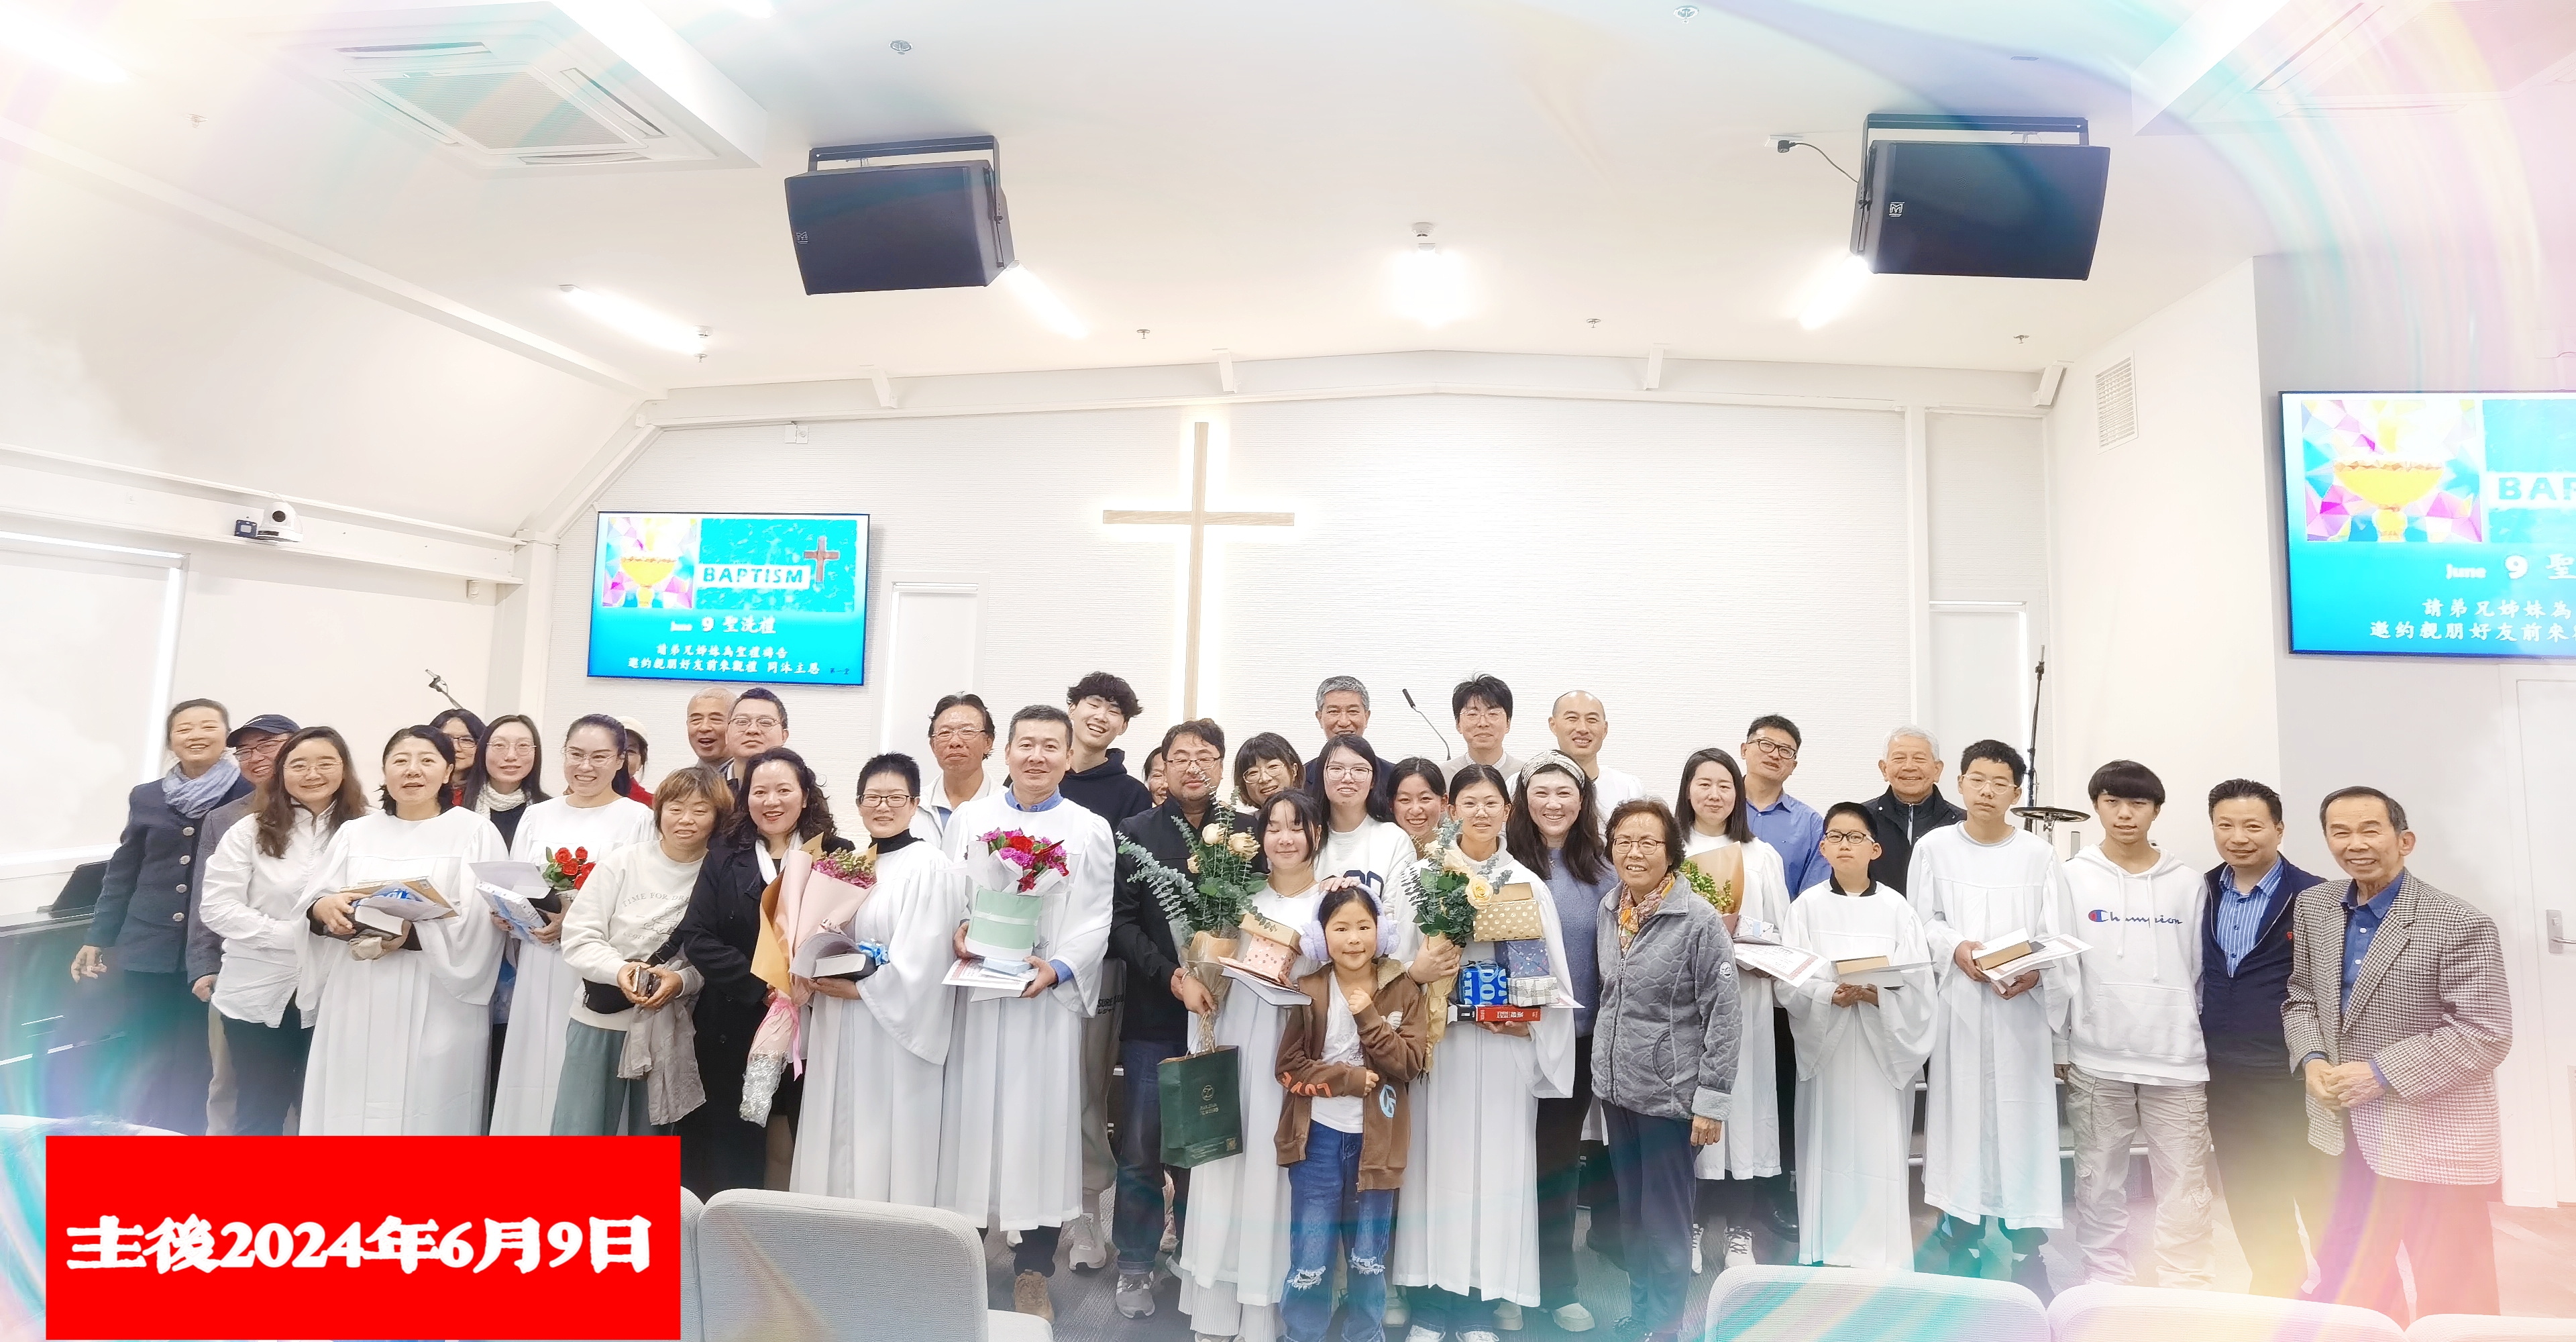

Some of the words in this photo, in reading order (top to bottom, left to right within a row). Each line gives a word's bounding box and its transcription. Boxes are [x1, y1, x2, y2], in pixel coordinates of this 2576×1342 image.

[703, 567, 803, 583] BAPTISM
[2504, 555, 2529, 579] 9
[702, 617, 714, 632] 9
[2369, 620, 2576, 643] 邀約親朋好友前來
[623, 893, 646, 907] TIME
[650, 892, 668, 900] FOR
[2088, 909, 2183, 928] Chmpion
